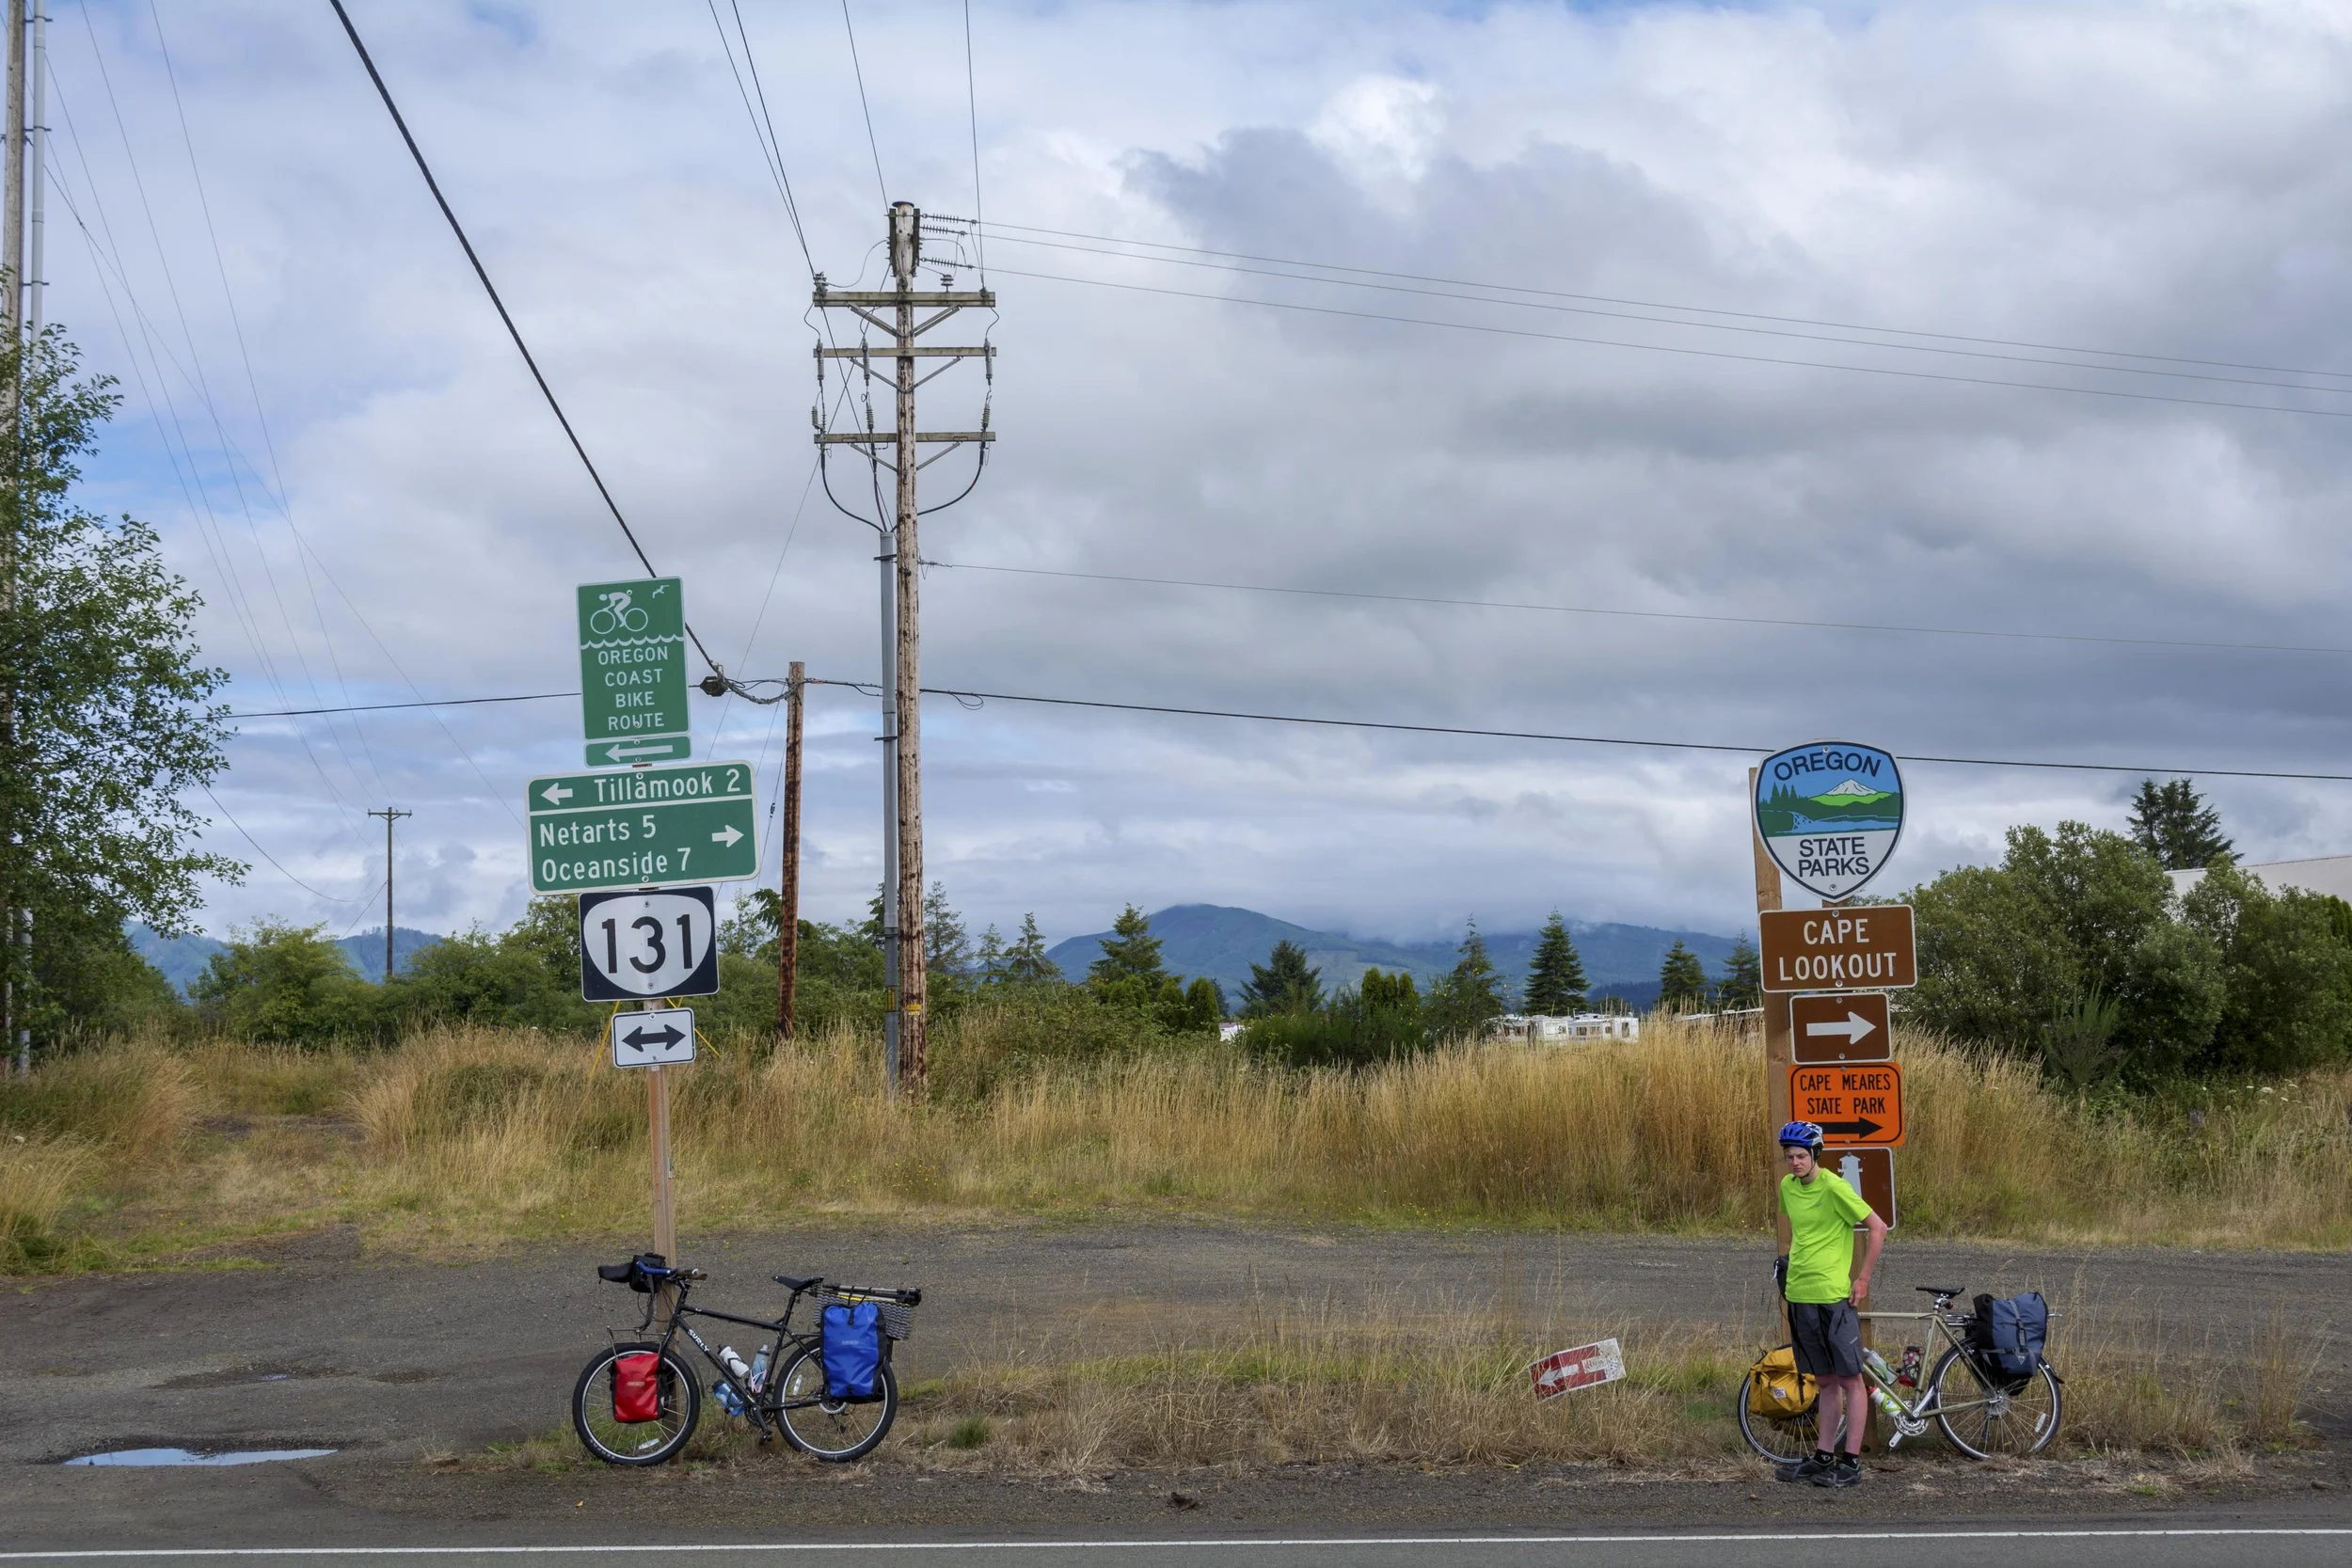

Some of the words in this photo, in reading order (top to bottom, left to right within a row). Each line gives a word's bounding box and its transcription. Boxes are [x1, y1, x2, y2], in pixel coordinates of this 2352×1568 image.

[598, 646, 668, 665] OREGON
[605, 669, 662, 687] COAST
[615, 691, 655, 708] BIKE
[608, 713, 664, 731] ROUTE
[1773, 752, 1881, 781] OREGON
[595, 771, 712, 802] Tillamook
[726, 768, 740, 792] 2
[540, 819, 630, 847] Netarts
[643, 815, 657, 838] 5
[1799, 836, 1866, 858] STATE
[542, 851, 668, 882] Oceanside
[677, 847, 691, 871] 7
[1798, 857, 1869, 878] PARKS
[1804, 918, 1870, 945] CAPE
[601, 913, 693, 974] 131
[1778, 952, 1898, 981] LOOKOUT
[1800, 1074, 1832, 1091] CAPE
[1842, 1073, 1891, 1091] MEARES
[1807, 1098, 1842, 1115] STATE
[1853, 1098, 1885, 1114] PARK
[687, 1328, 710, 1353] SURLY
